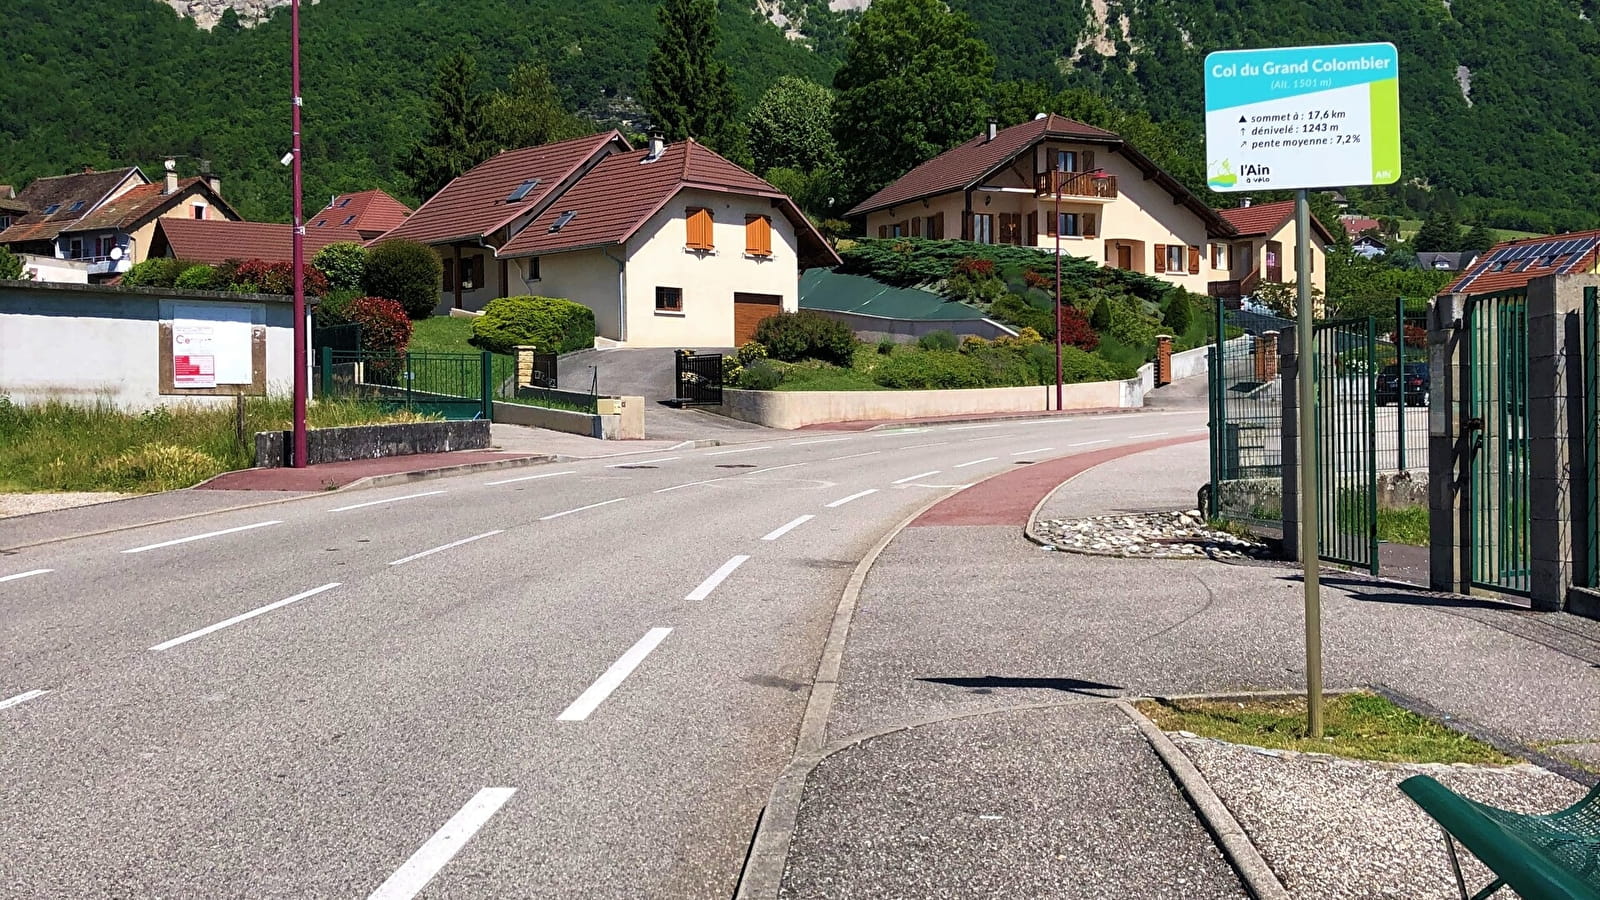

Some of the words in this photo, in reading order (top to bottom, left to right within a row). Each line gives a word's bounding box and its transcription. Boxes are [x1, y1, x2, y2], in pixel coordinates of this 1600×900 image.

[1212, 64, 1236, 78] Col
[1240, 62, 1258, 76] du
[1263, 60, 1308, 75] Grand
[1312, 57, 1390, 72] Colombier
[1270, 80, 1290, 90] (Alt.
[1294, 79, 1317, 88] 1501
[1319, 78, 1332, 88] m)
[1250, 114, 1290, 123] sommet
[1292, 112, 1298, 121] à
[1307, 110, 1329, 120] 17,6
[1331, 110, 1346, 119] km
[1251, 126, 1293, 136] dénivelé
[1302, 123, 1327, 132] 1243
[1251, 139, 1280, 150] pente
[1282, 136, 1328, 148] moyenne
[1336, 134, 1361, 144] 7,2%
[1240, 164, 1270, 176] l'Ain
